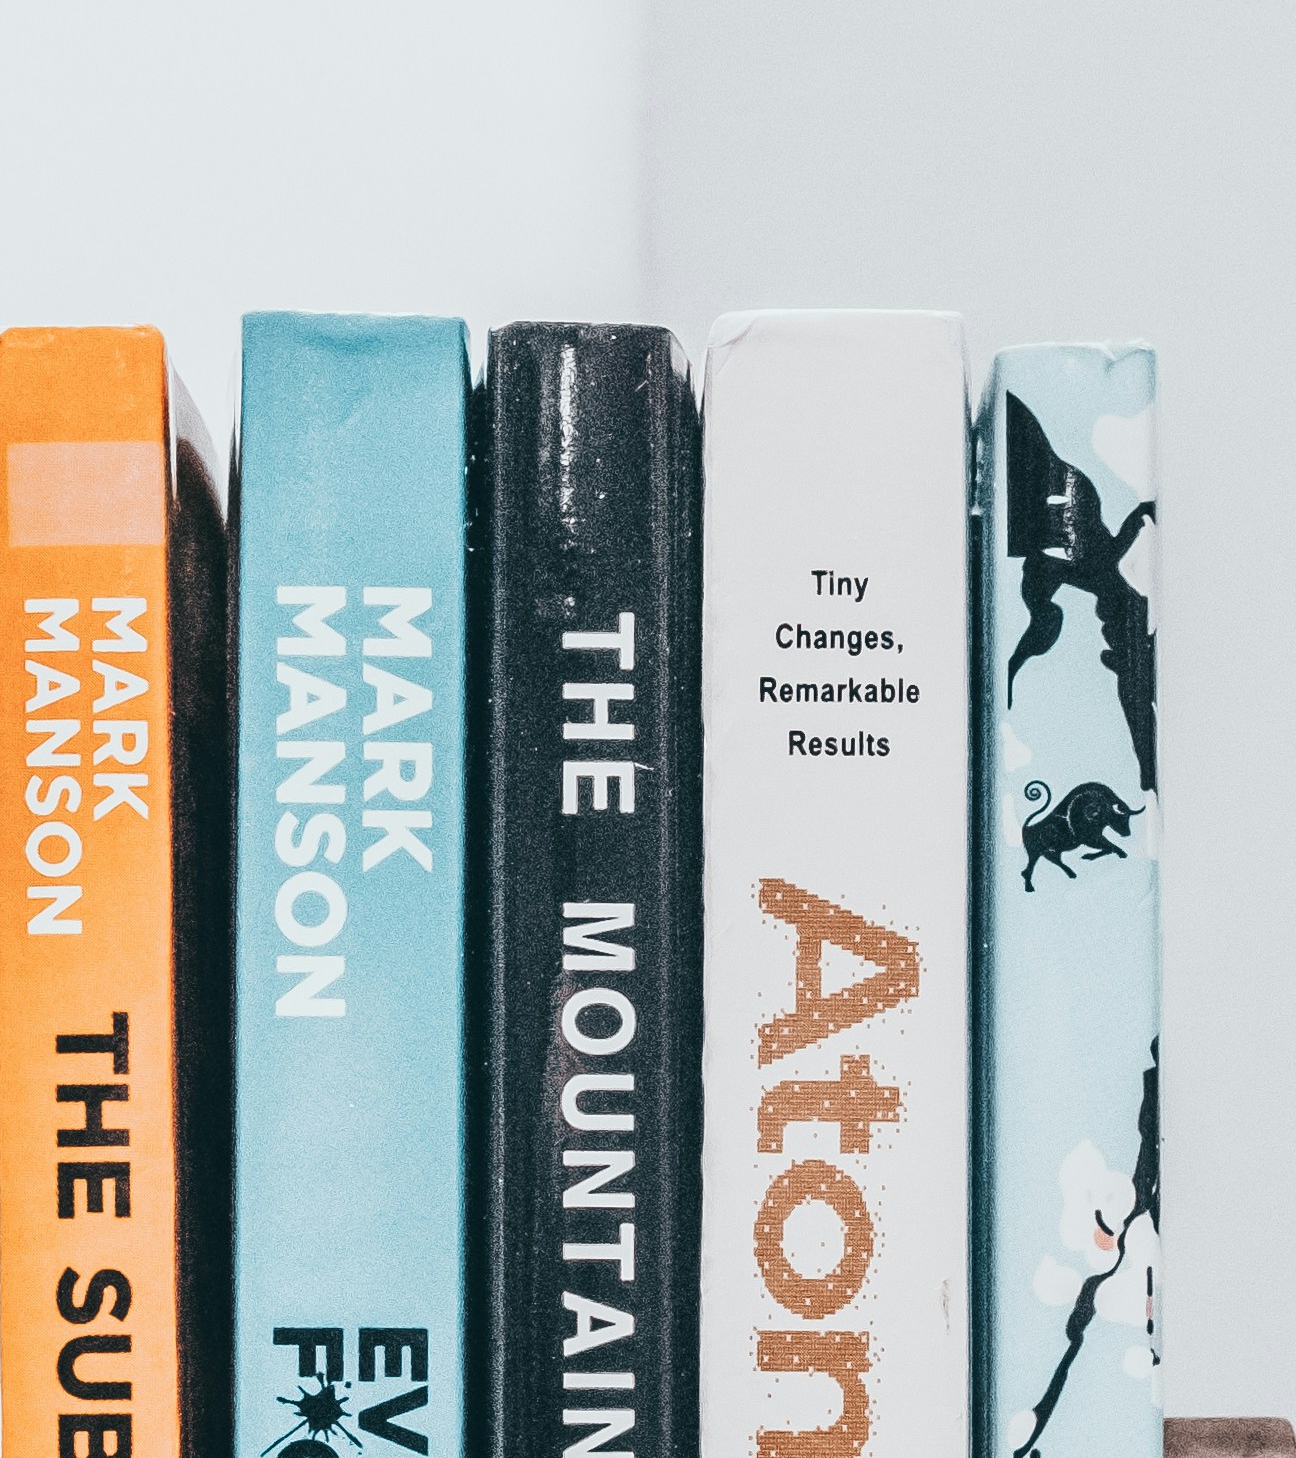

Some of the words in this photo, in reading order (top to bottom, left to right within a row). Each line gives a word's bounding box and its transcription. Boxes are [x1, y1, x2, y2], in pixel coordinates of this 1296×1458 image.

[774, 623, 905, 656] Changes,
[811, 569, 869, 602] Tiny
[24, 597, 84, 936] MANSON
[91, 597, 150, 822] MARK
[362, 586, 434, 875] MARK
[561, 611, 635, 815] THE
[758, 676, 921, 705] Remarkable
[788, 729, 891, 757] Results
[275, 585, 349, 1019] MANSON
[55, 1011, 131, 1219] THE
